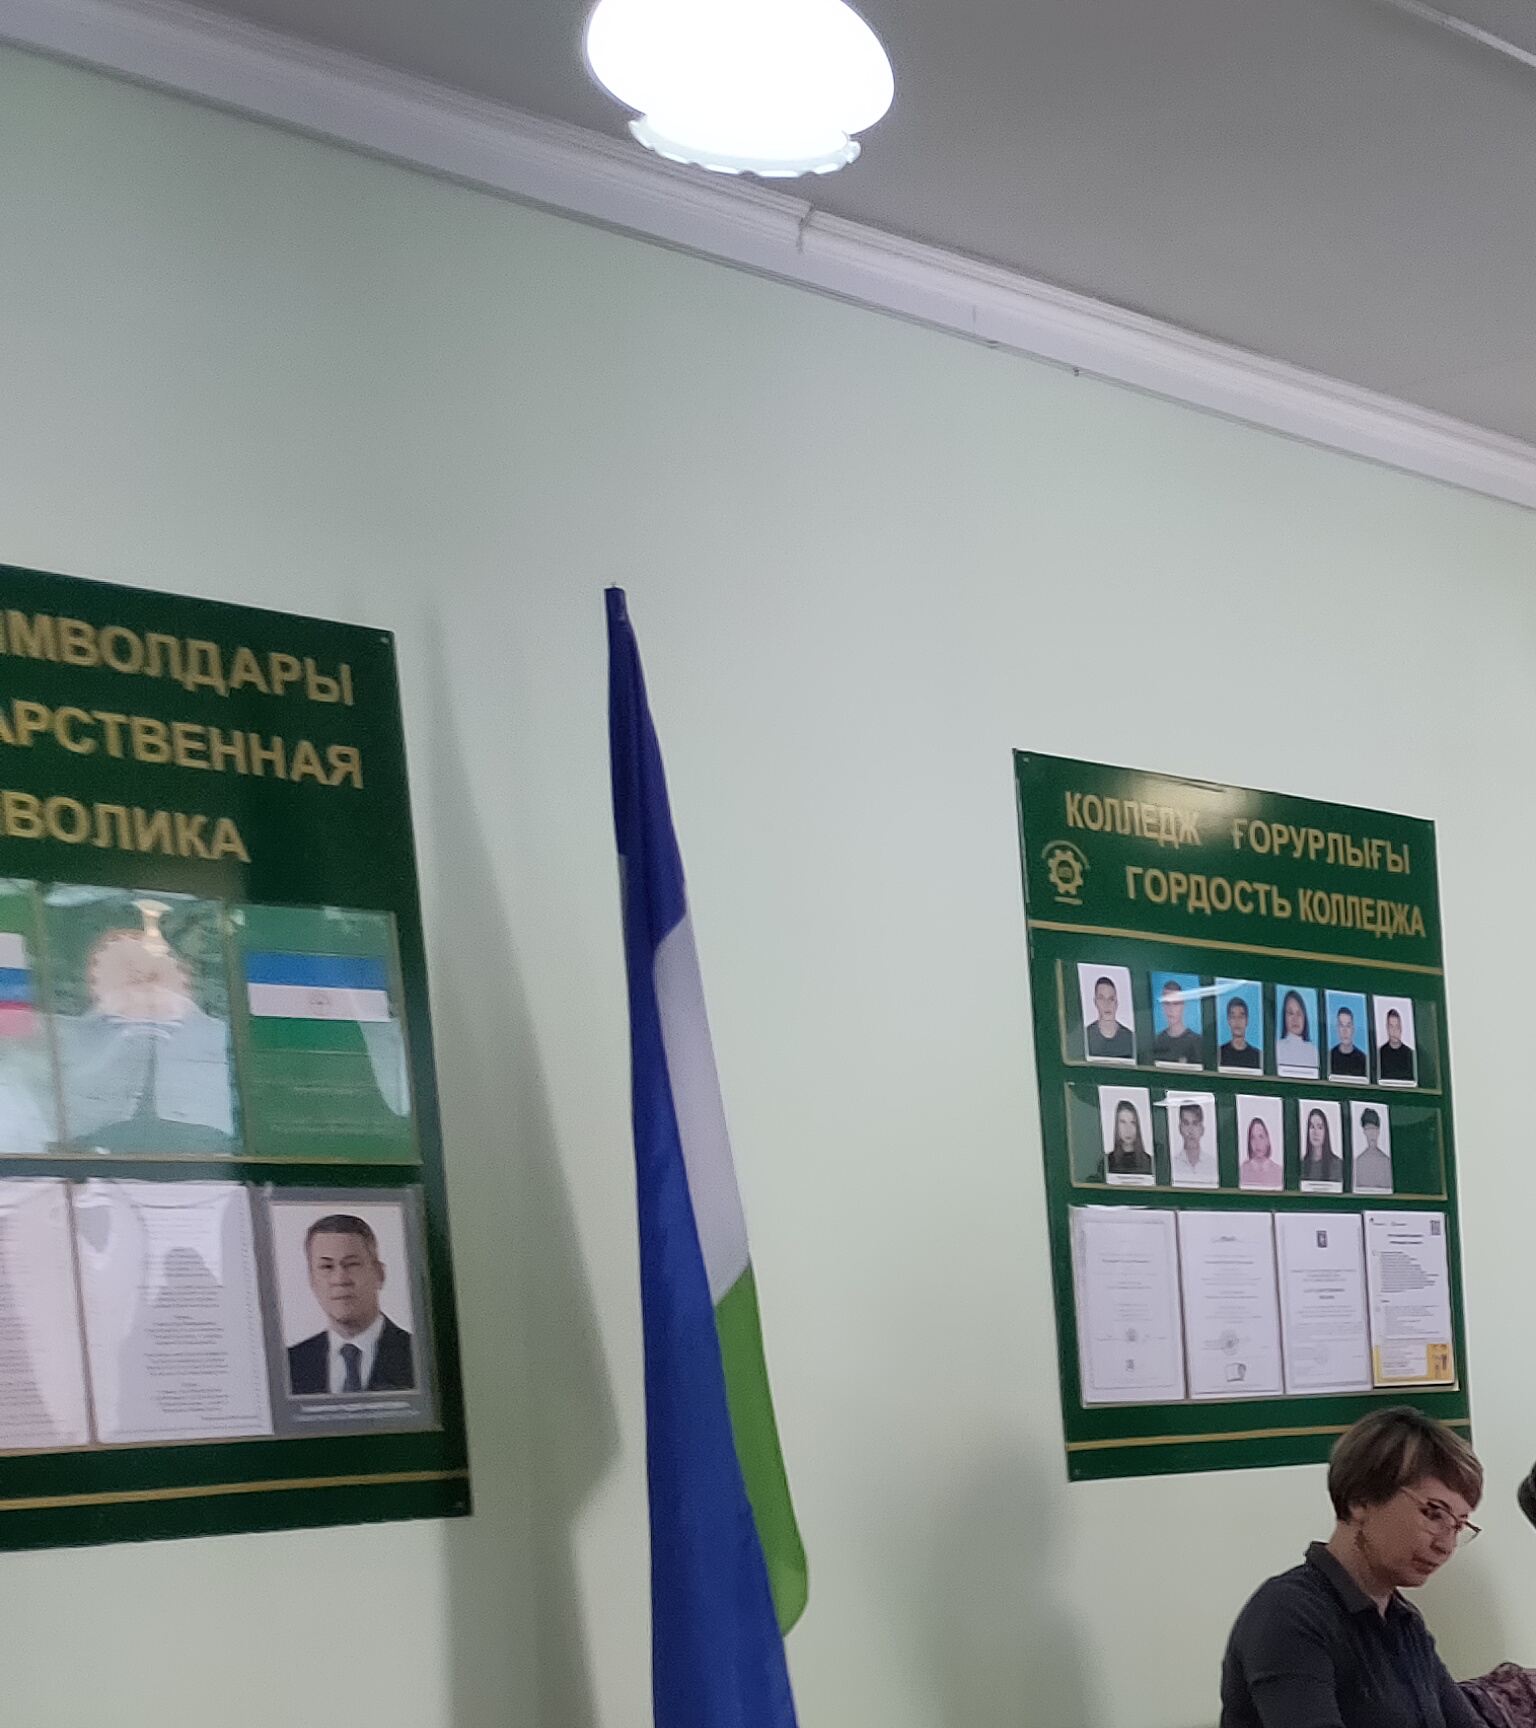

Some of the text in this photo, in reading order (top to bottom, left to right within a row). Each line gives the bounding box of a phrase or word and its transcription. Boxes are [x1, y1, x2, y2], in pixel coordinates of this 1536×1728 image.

[0, 609, 355, 706] МВОЛДАРЫ
[0, 790, 251, 862] ВОЛИКА
[1065, 791, 1201, 849] КОЛЛЕДЖ
[1125, 865, 1427, 940] ГОРДОСТЬ КОЛЛЕДЖА
